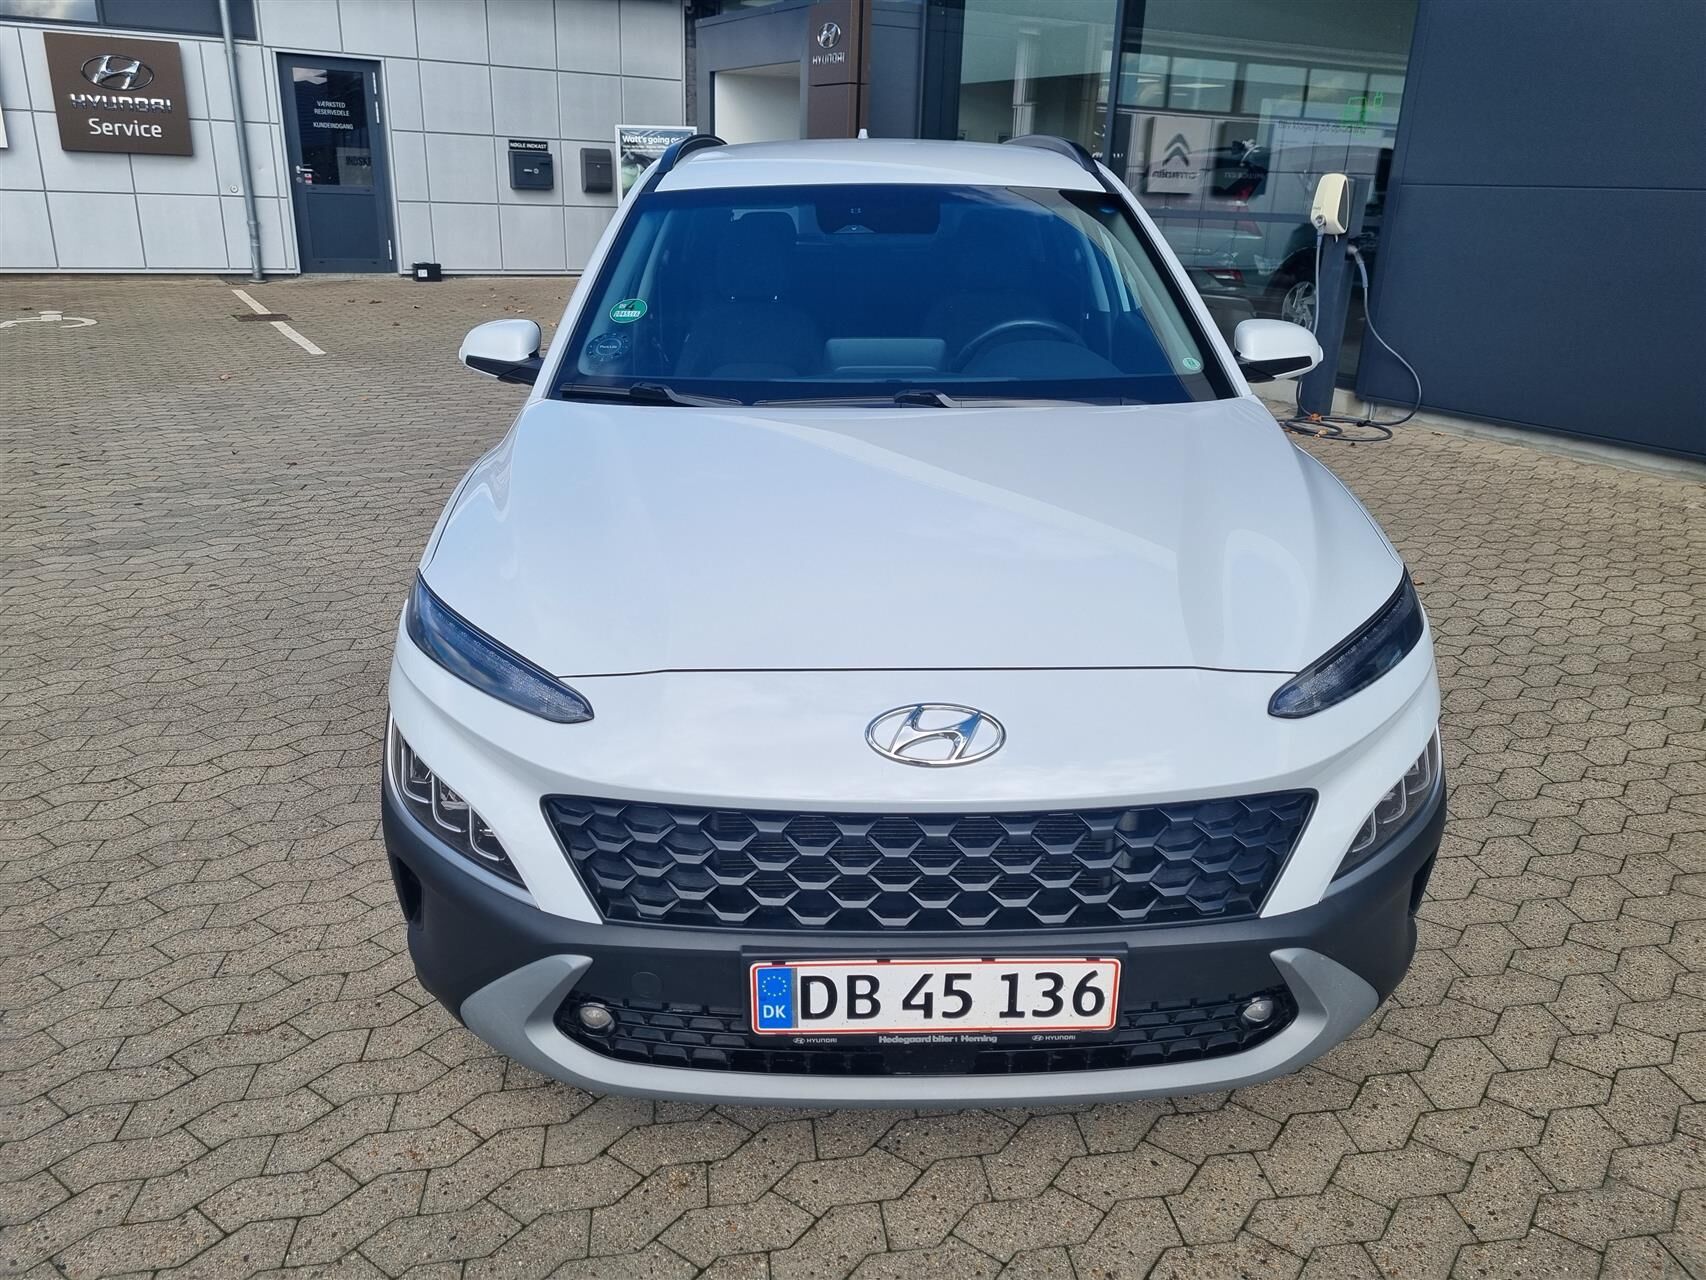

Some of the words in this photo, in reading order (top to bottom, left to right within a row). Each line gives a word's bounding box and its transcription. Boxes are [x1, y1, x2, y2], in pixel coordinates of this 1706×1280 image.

[812, 52, 845, 65] HYUNDAI
[68, 92, 173, 113] HYUNDAI
[88, 118, 162, 138] Service
[622, 135, 647, 143] Watt's
[648, 136, 670, 145] going
[800, 975, 881, 1021] DB
[902, 972, 974, 1020] 45
[999, 970, 1106, 1019] 136
[763, 1004, 787, 1019] DK
[879, 1036, 931, 1044] Hedegaard
